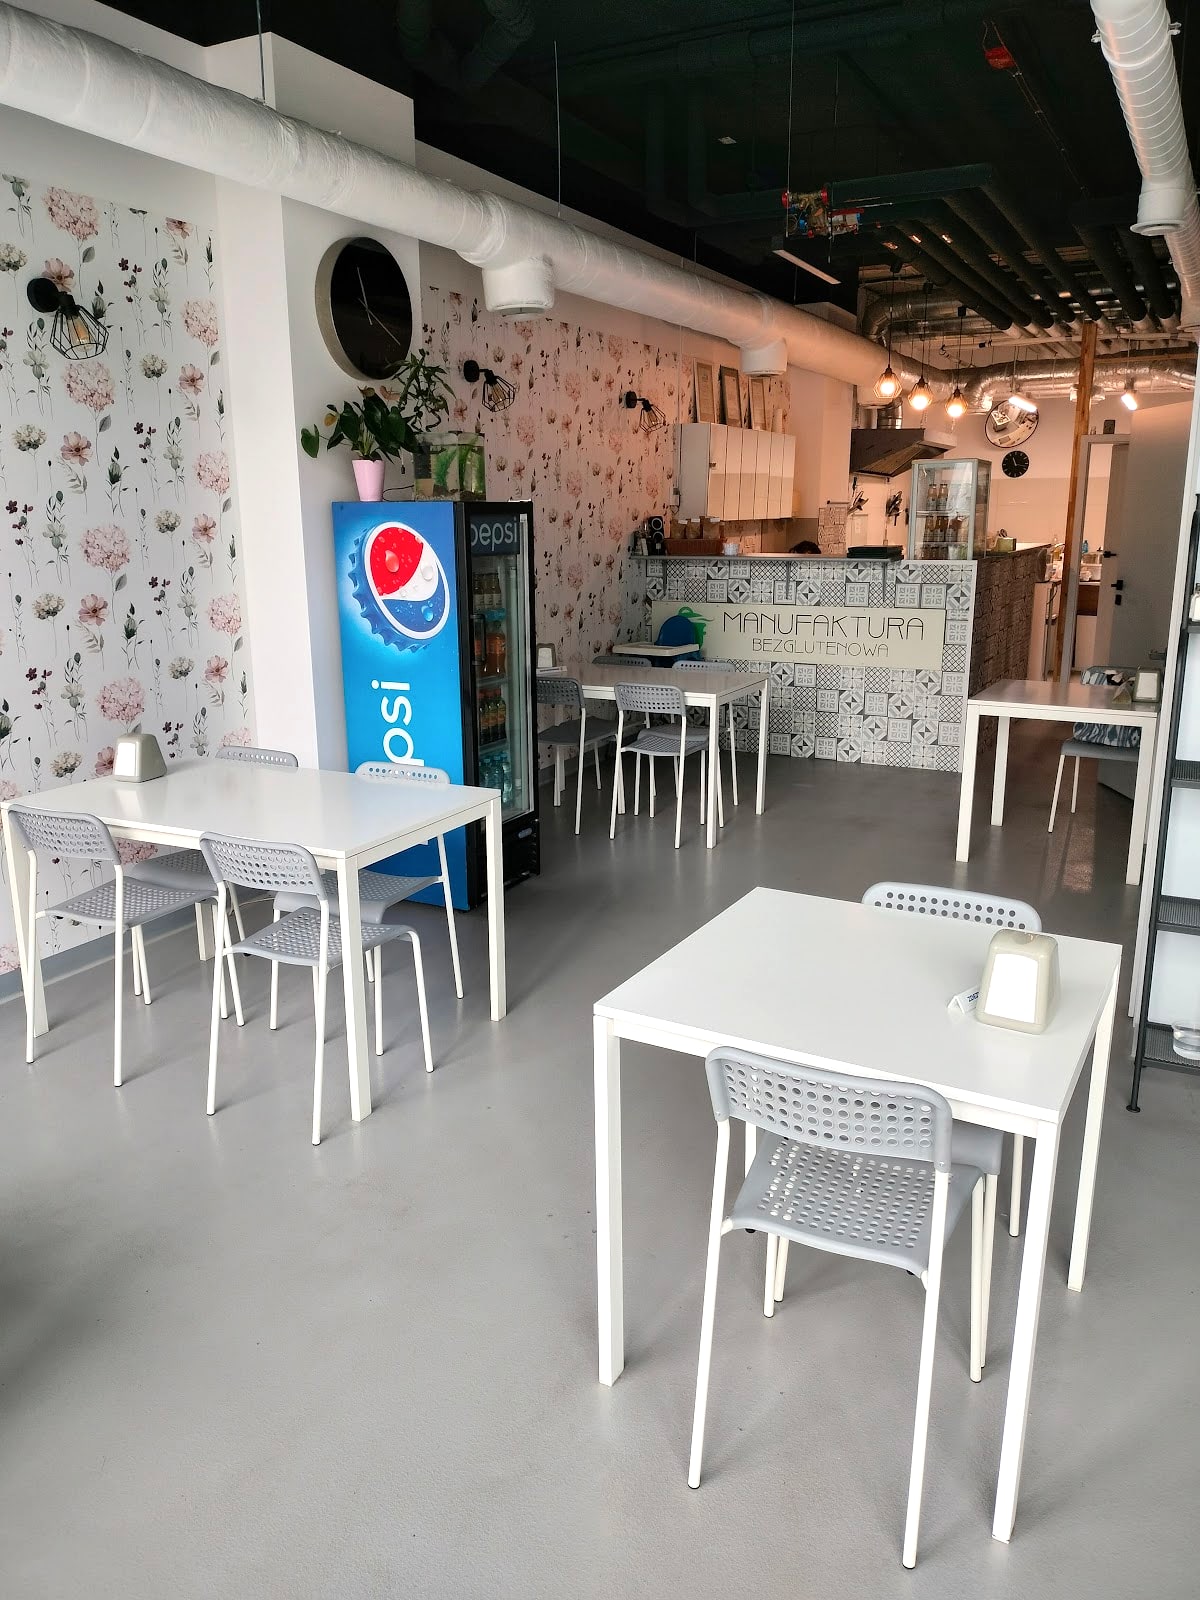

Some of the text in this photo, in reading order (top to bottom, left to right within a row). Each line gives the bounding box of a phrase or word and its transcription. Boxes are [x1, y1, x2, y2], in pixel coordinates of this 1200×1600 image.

[722, 611, 925, 641] MANUFAKTURA
[752, 637, 889, 658] BEZGLUTENOWA
[371, 679, 425, 767] psi
